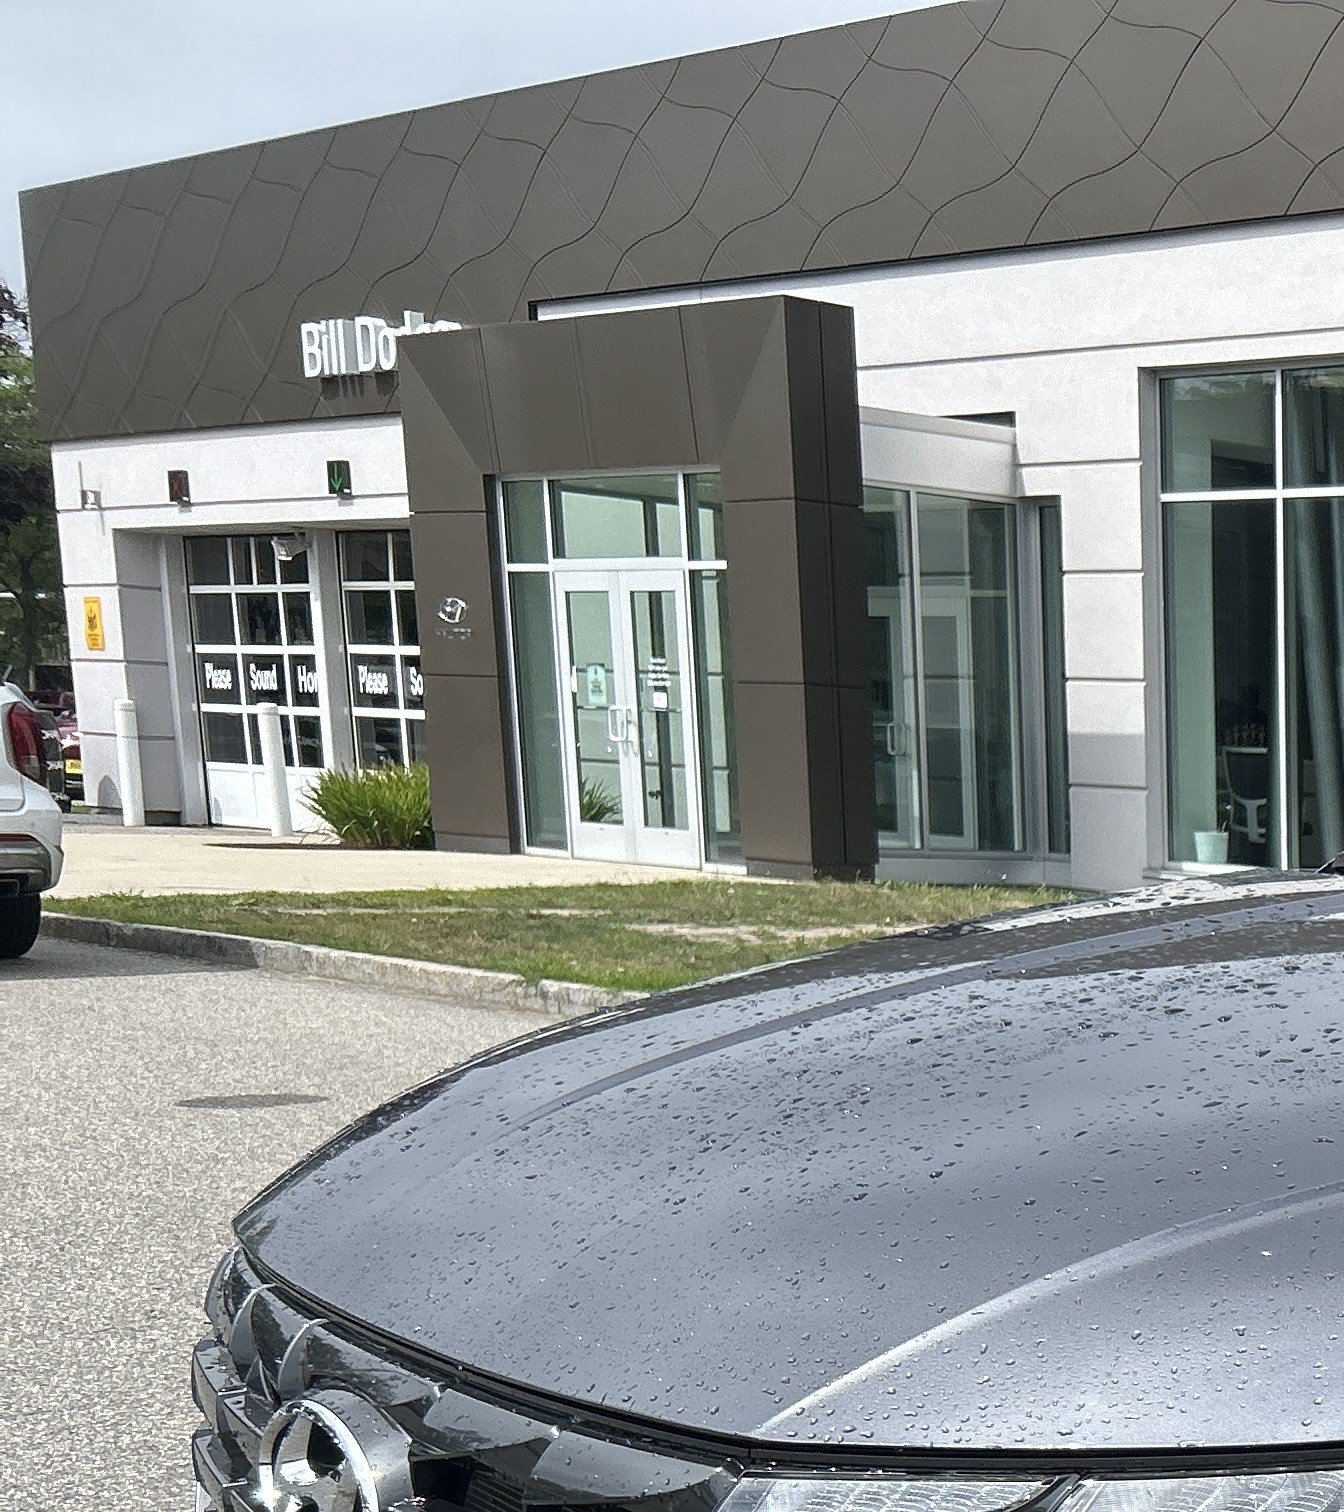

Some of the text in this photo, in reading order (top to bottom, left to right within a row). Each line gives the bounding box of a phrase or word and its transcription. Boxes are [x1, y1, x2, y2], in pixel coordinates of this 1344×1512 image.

[300, 318, 347, 378] Bill
[204, 662, 233, 690] Please
[249, 663, 278, 691] Sound
[357, 664, 389, 695] Please
